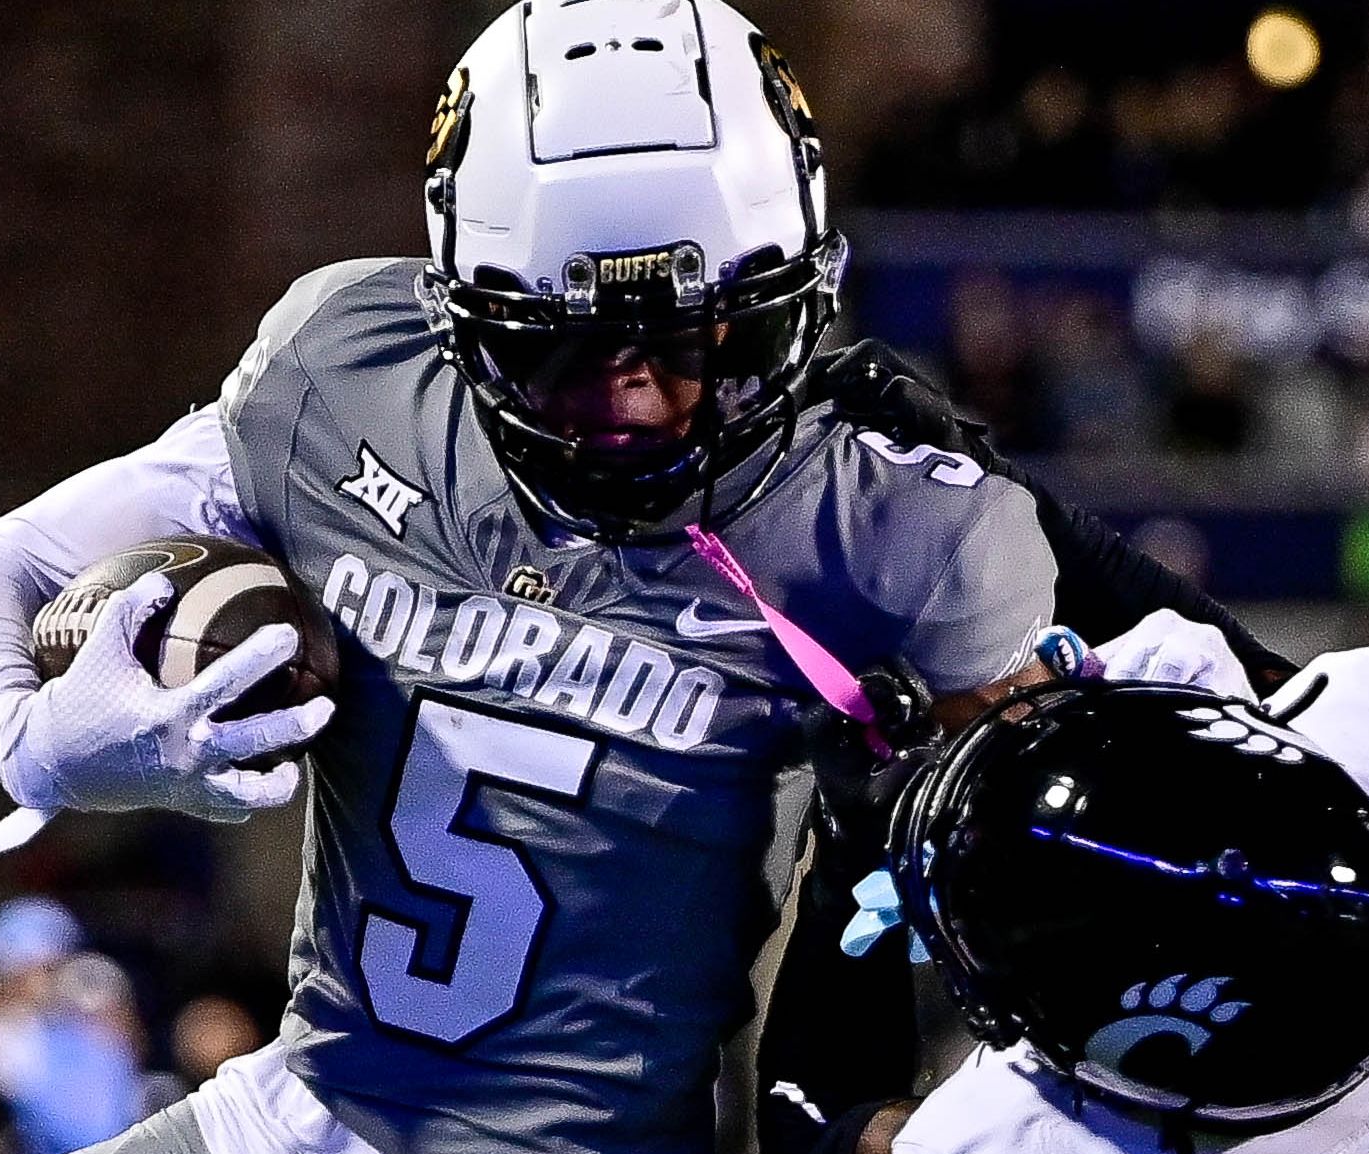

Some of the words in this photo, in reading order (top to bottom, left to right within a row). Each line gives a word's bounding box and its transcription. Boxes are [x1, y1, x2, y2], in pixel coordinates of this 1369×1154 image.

[599, 251, 671, 284] BUFFS
[323, 553, 726, 751] COLORADO
[359, 698, 598, 1044] 5
